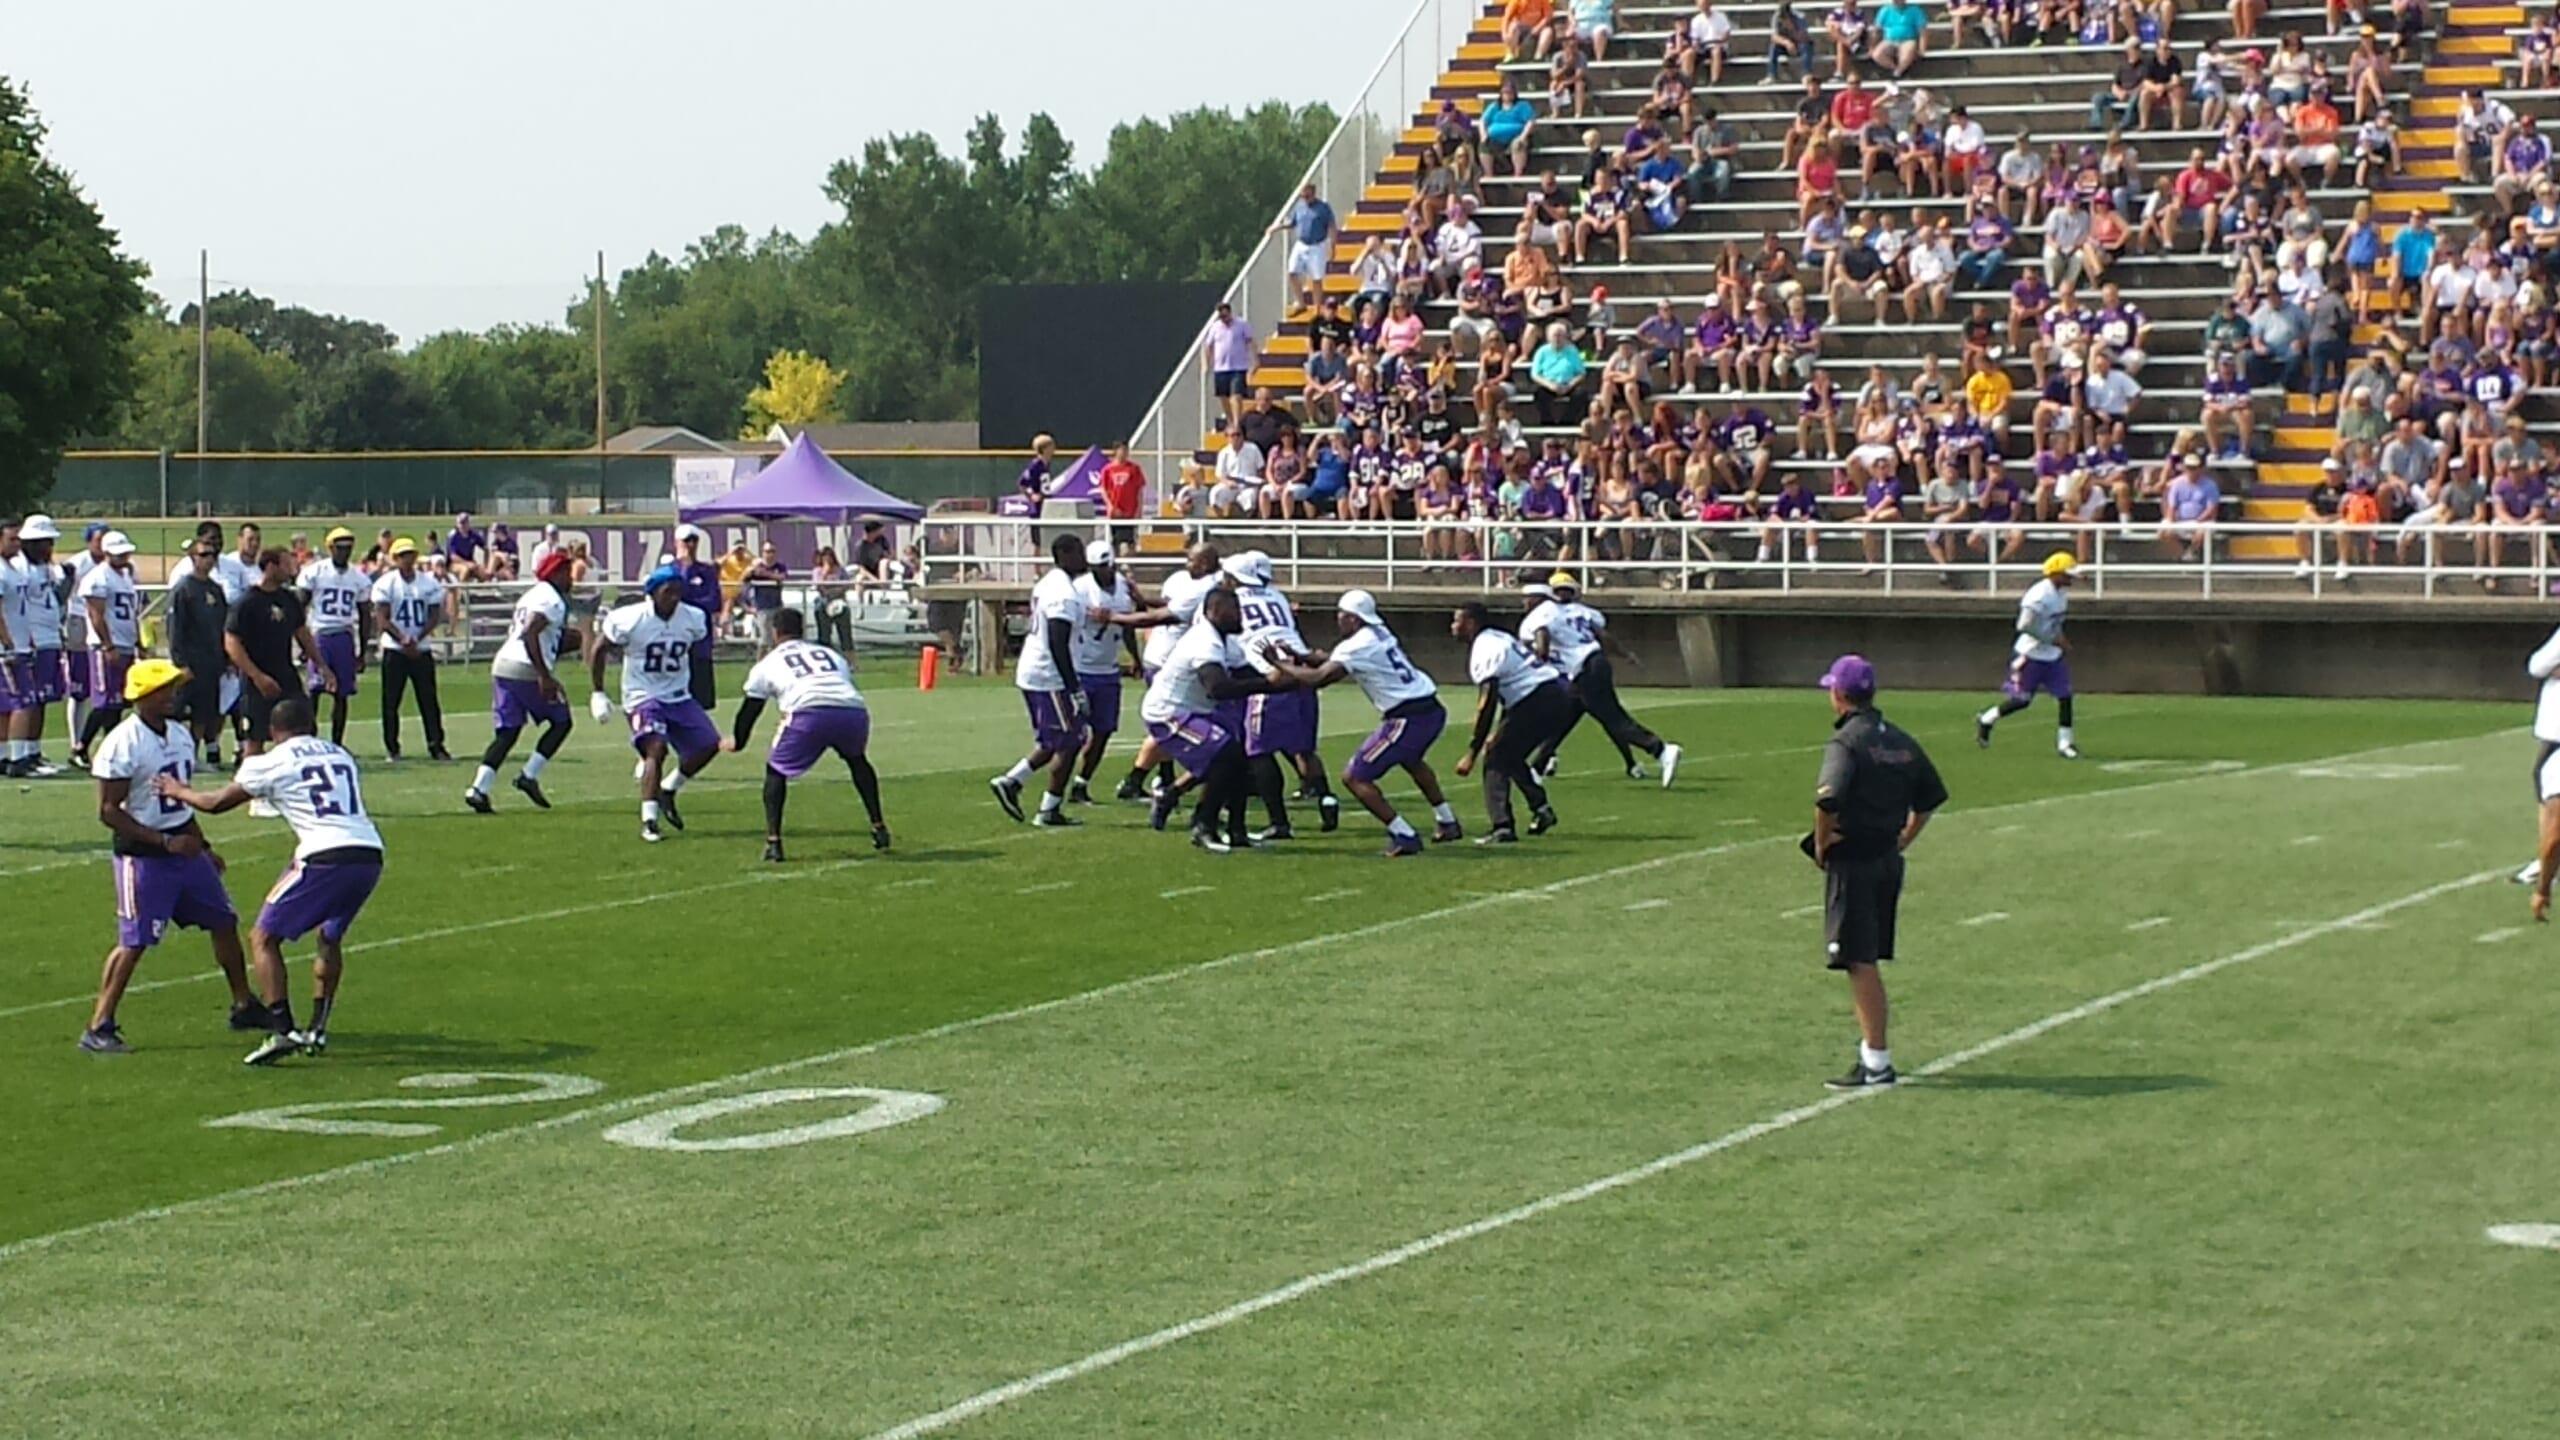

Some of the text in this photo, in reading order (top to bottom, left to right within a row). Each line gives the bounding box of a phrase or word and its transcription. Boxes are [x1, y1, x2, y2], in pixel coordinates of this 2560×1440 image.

[396, 599, 425, 628] 40
[1242, 602, 1289, 631] 90
[644, 641, 687, 672] 69
[784, 650, 838, 679] 99
[302, 764, 359, 819] 27
